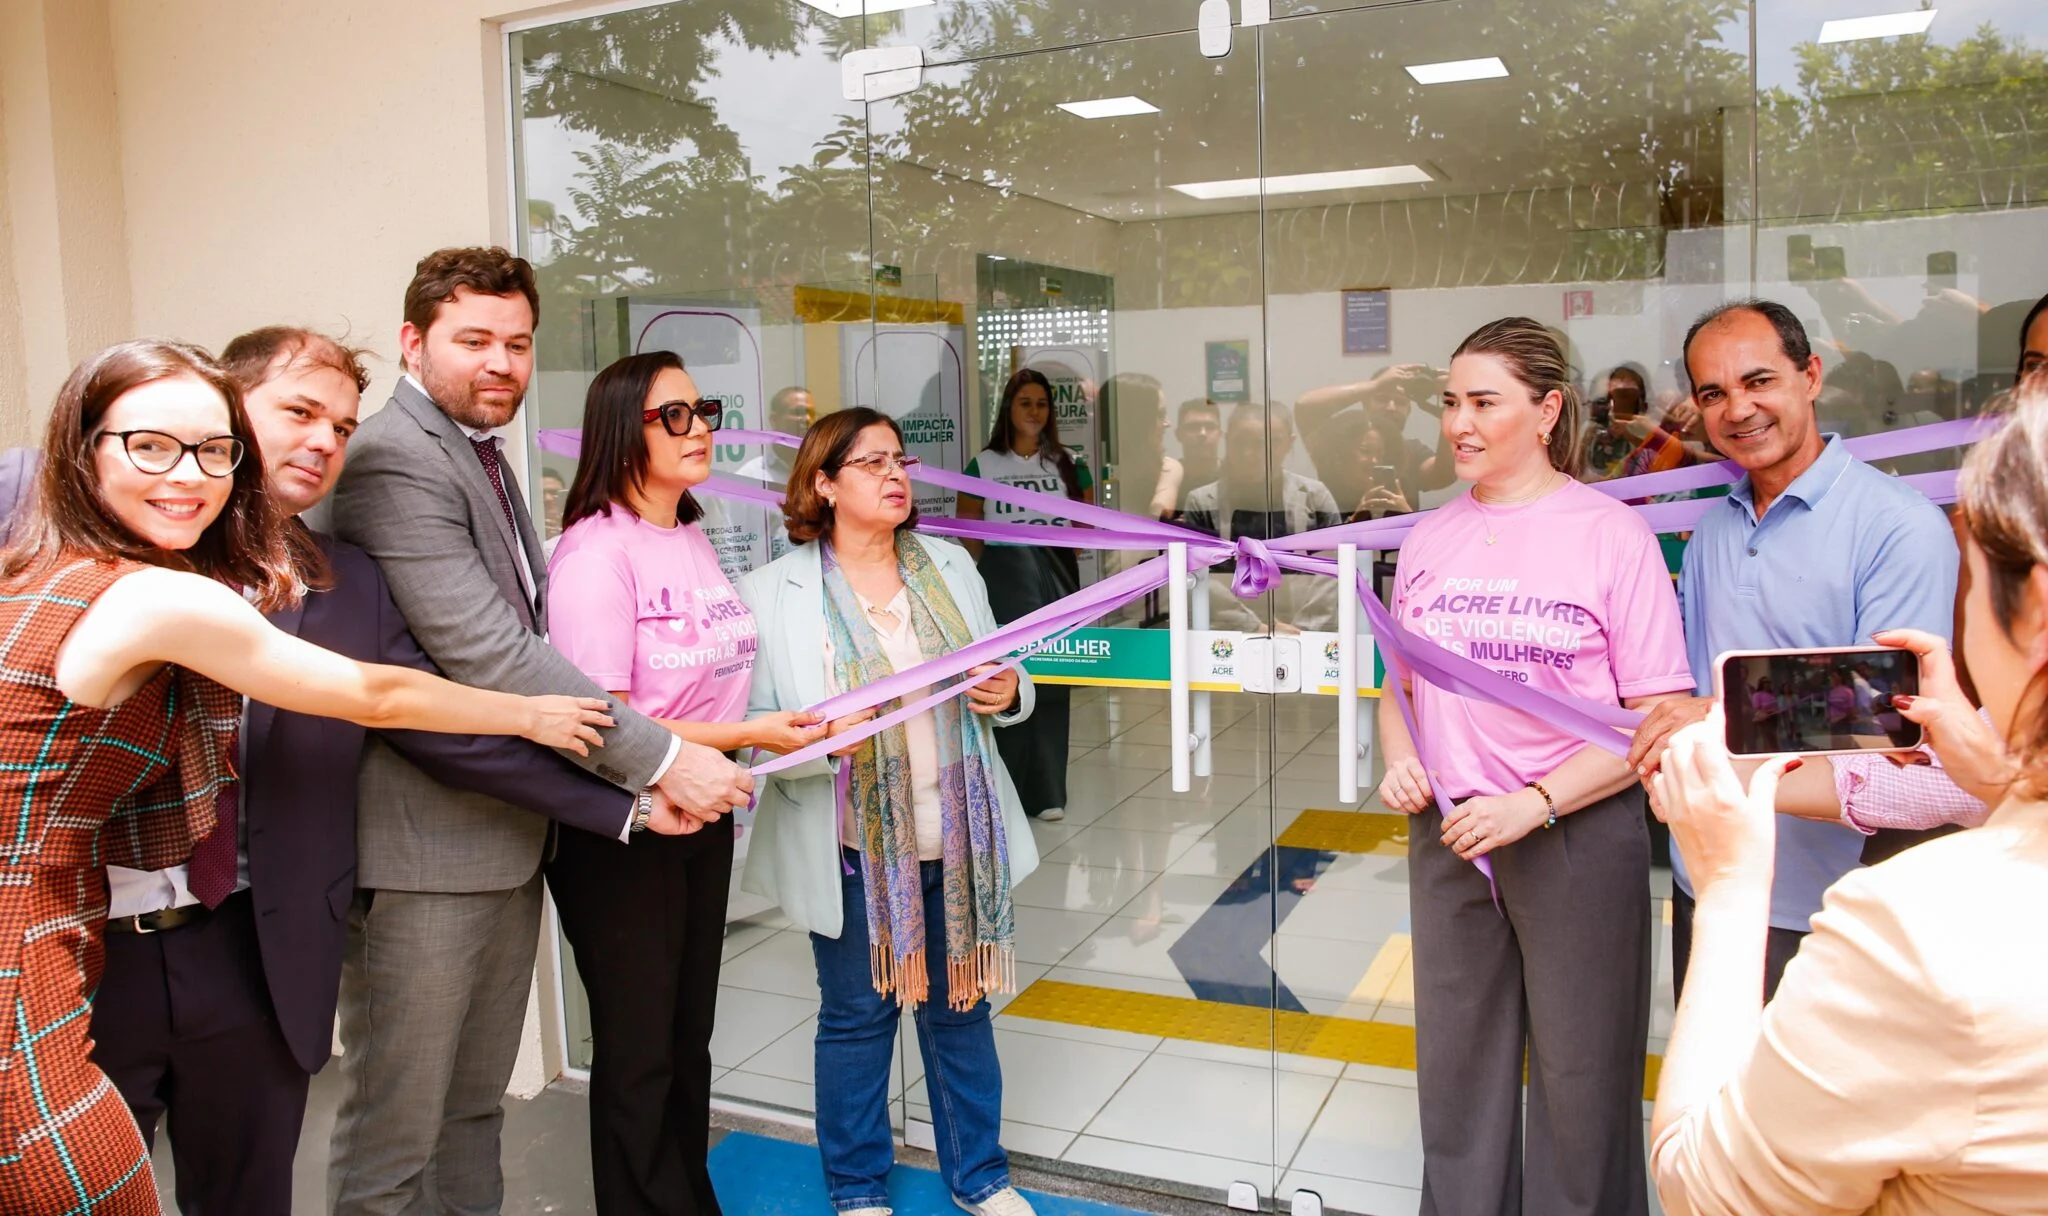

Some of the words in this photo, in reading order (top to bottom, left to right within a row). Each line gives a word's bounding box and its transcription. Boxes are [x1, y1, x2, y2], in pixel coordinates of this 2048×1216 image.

[902, 419, 955, 431] IMPACTA
[904, 431, 954, 444] MULHER
[734, 525, 742, 534] DE
[1443, 578, 1482, 592] POR
[1487, 579, 1518, 592] UM
[1428, 595, 1504, 615] ACRE
[1508, 596, 1585, 627] LIVRE
[1425, 617, 1454, 637] DE
[1458, 617, 1582, 651] VIOLÊNCIA
[648, 648, 722, 670] CONTRA
[724, 643, 736, 659] AS
[1212, 667, 1234, 676] ACRE
